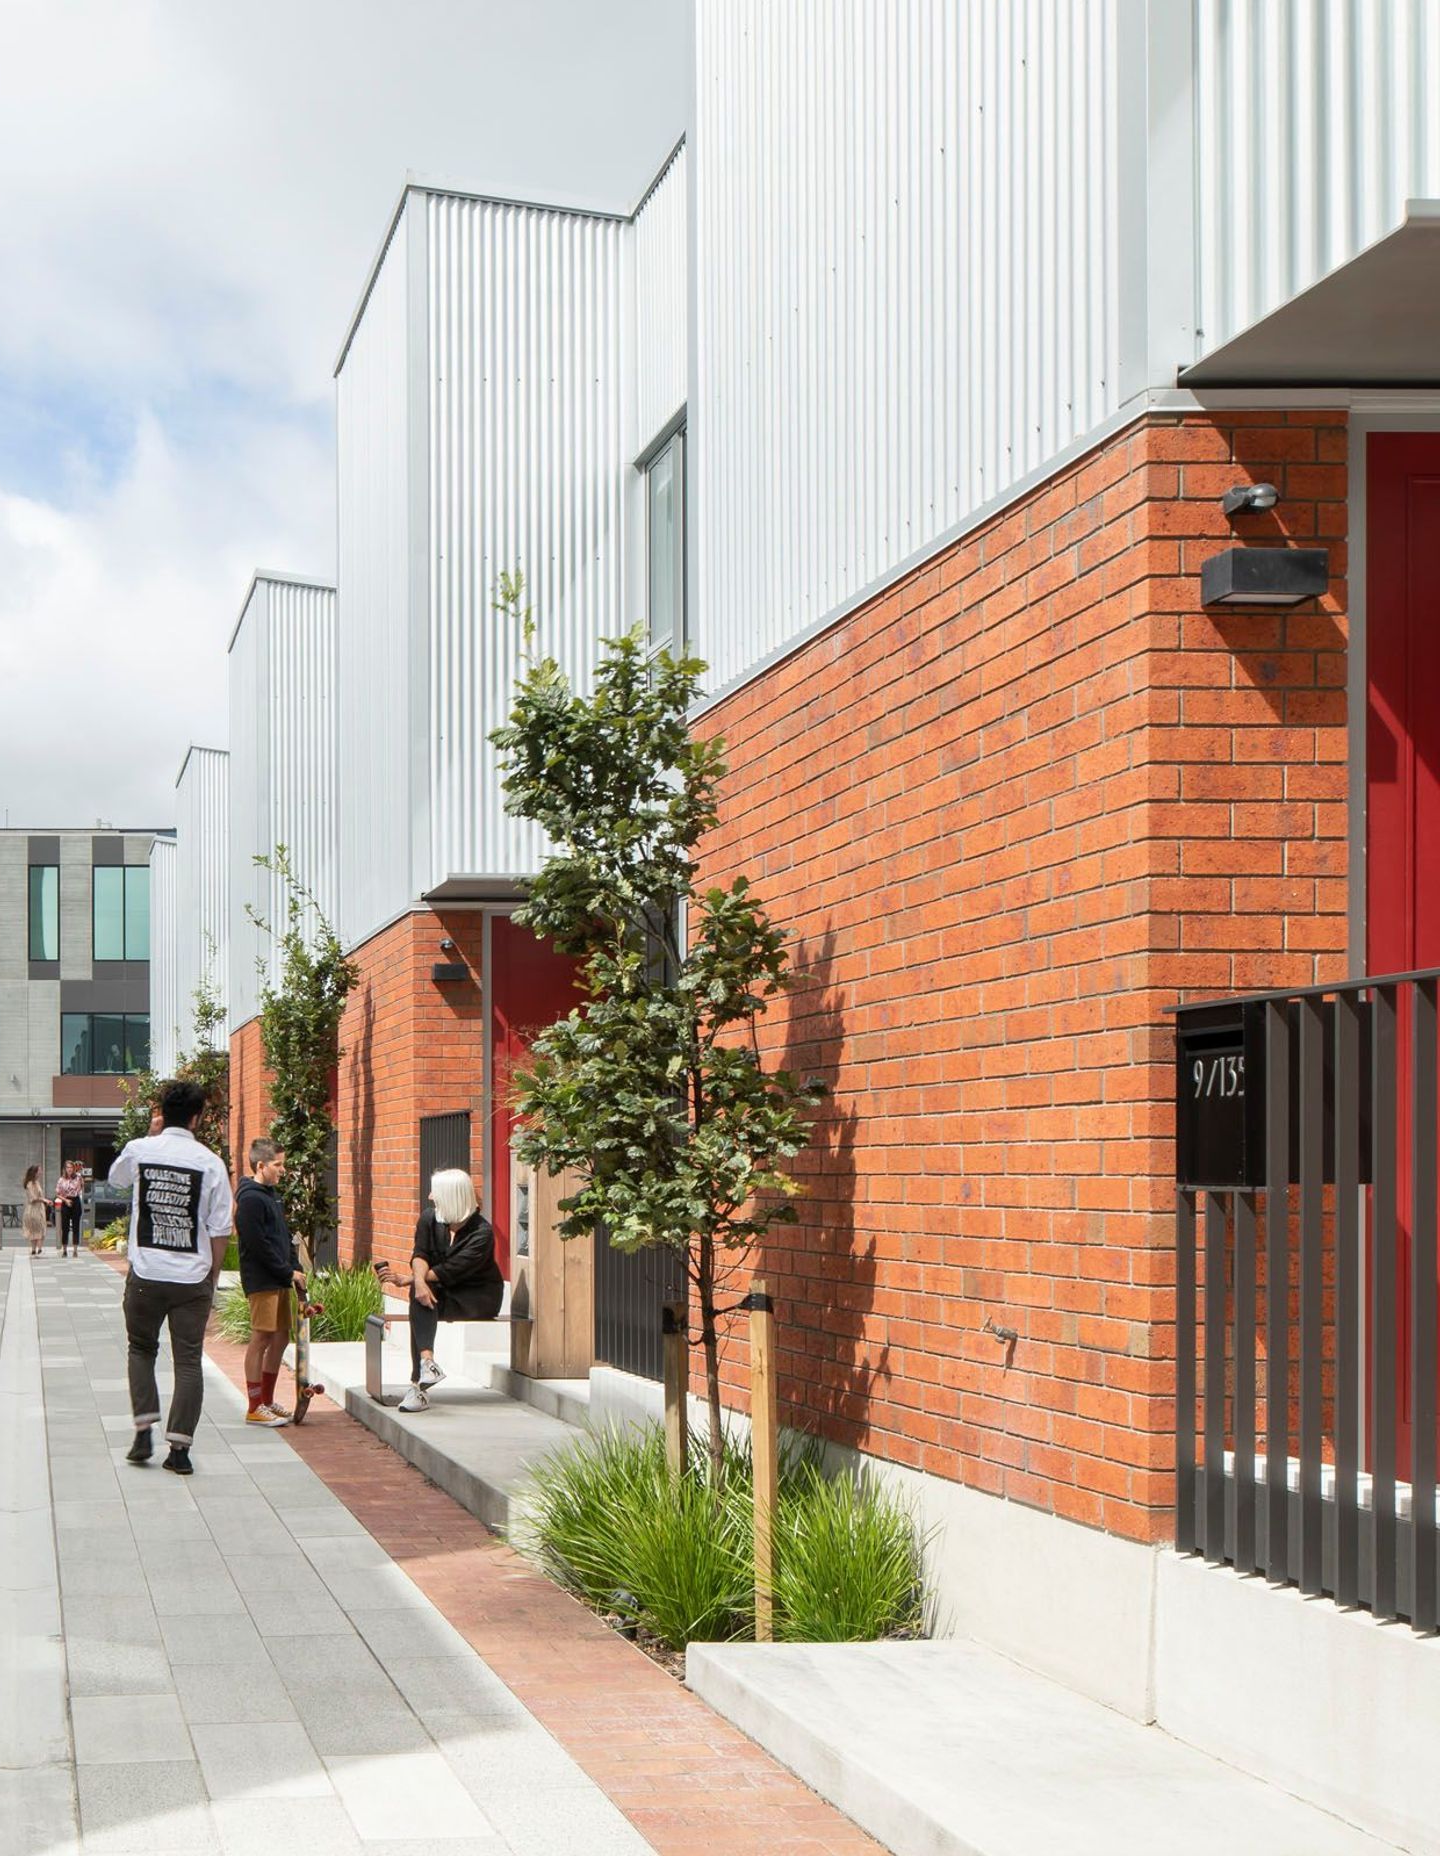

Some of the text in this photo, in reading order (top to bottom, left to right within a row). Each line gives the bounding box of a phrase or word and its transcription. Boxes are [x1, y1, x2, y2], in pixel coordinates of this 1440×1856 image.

[144, 1168, 191, 1185] COLLECTIVE
[146, 1190, 191, 1207] COLLECTIVE
[152, 1225, 192, 1248] DELUSION
